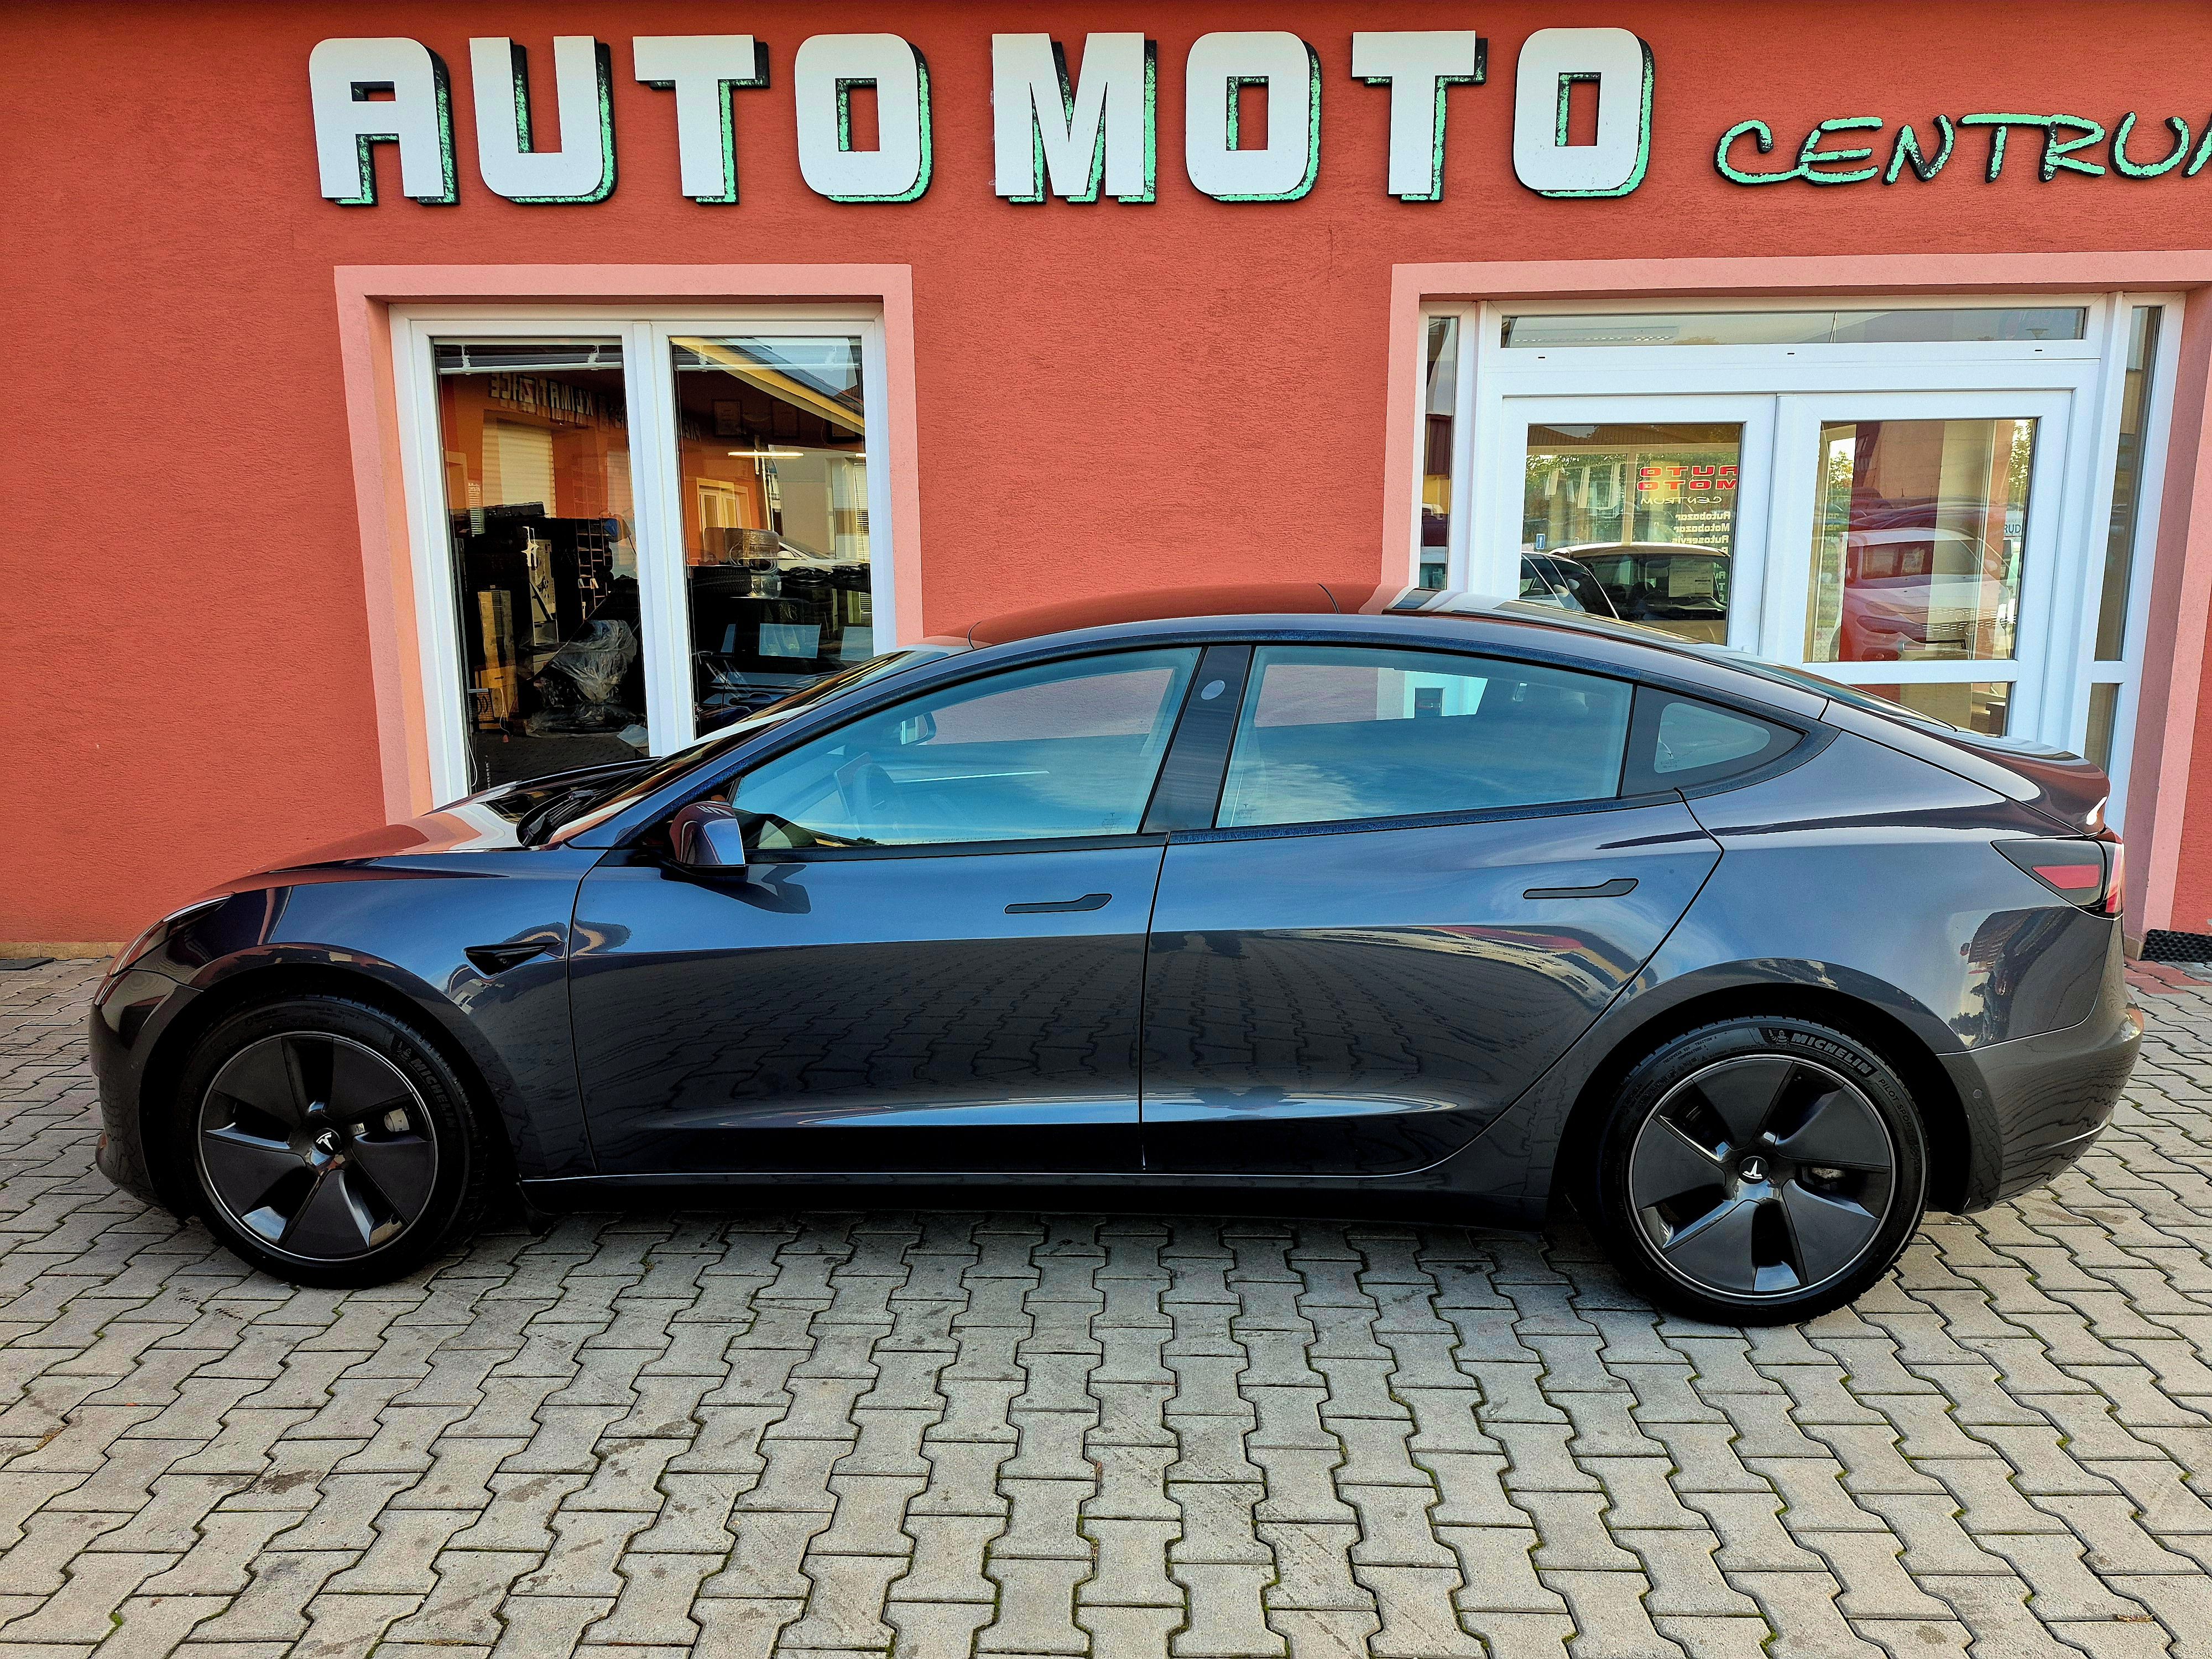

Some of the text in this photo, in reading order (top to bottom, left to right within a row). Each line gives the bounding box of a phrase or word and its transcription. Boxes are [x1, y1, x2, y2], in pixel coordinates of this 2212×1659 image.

[309, 28, 1655, 205] AUTO MOTO
[1713, 112, 2212, 186] CENTRU
[1791, 1033, 1872, 1074] MICHELIN
[1878, 1078, 1900, 1102] PILOT
